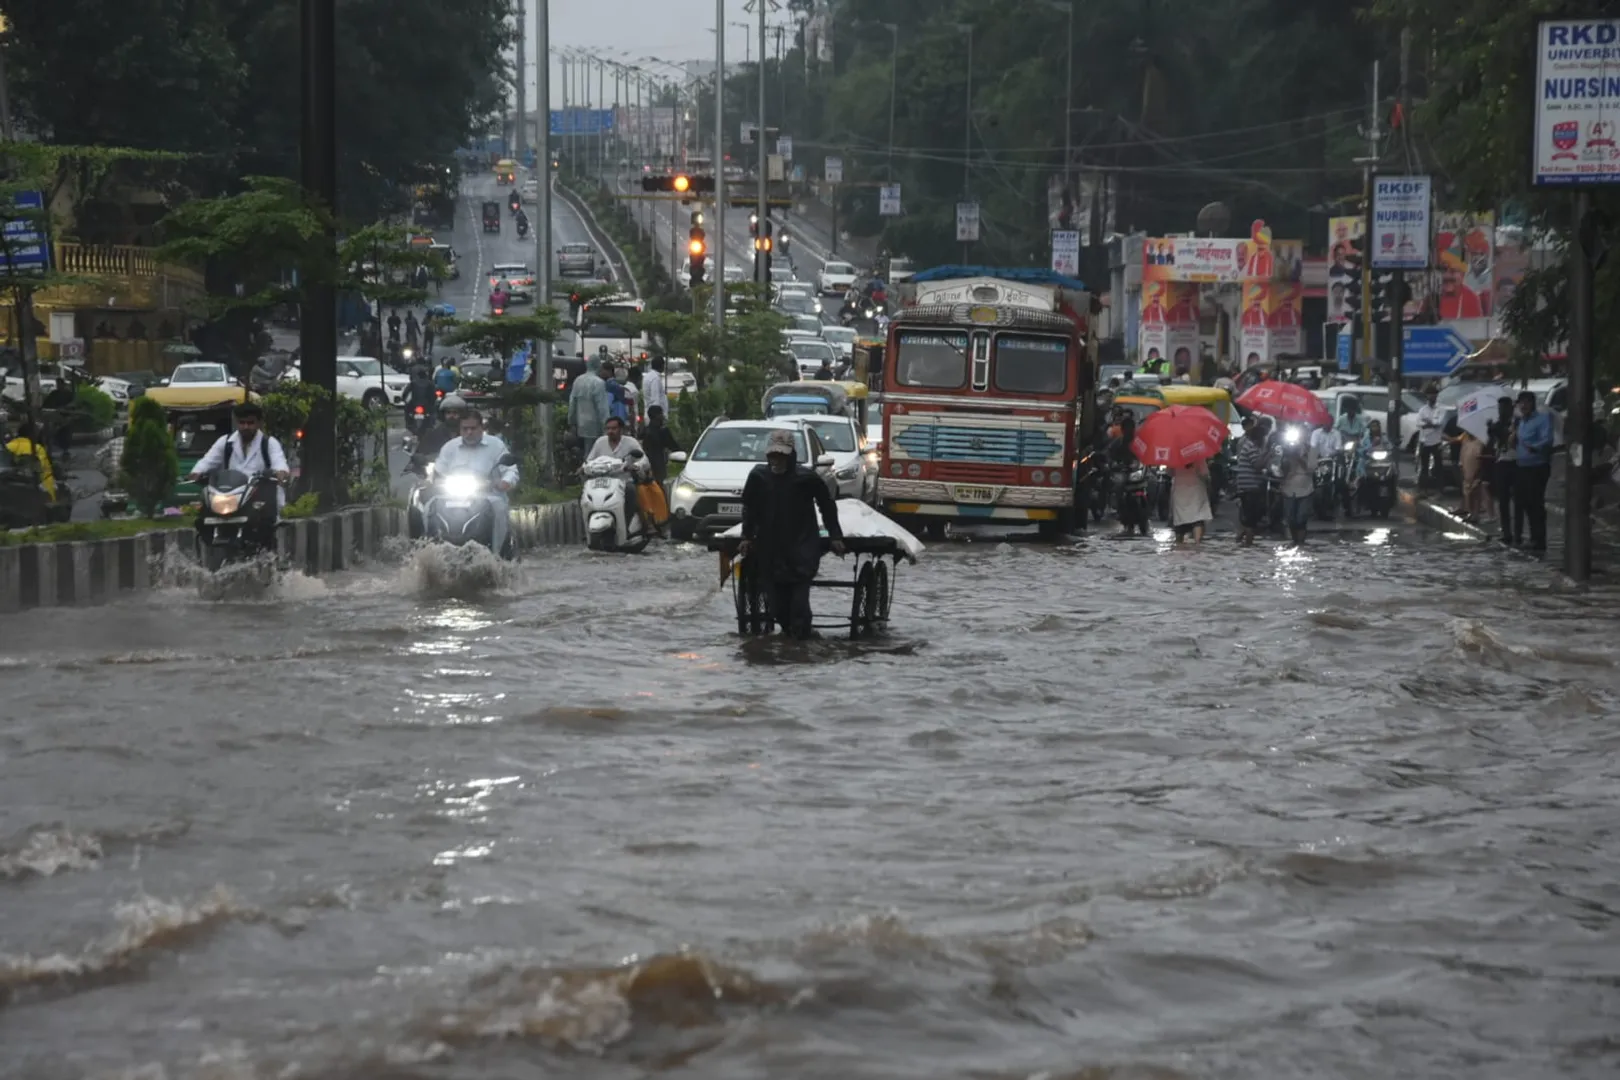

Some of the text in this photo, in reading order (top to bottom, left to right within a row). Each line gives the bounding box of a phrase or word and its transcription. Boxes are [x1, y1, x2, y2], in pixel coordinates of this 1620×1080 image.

[1549, 24, 1620, 45] RKD
[1378, 182, 1424, 194] RKDF
[1376, 210, 1424, 222] NURSING
